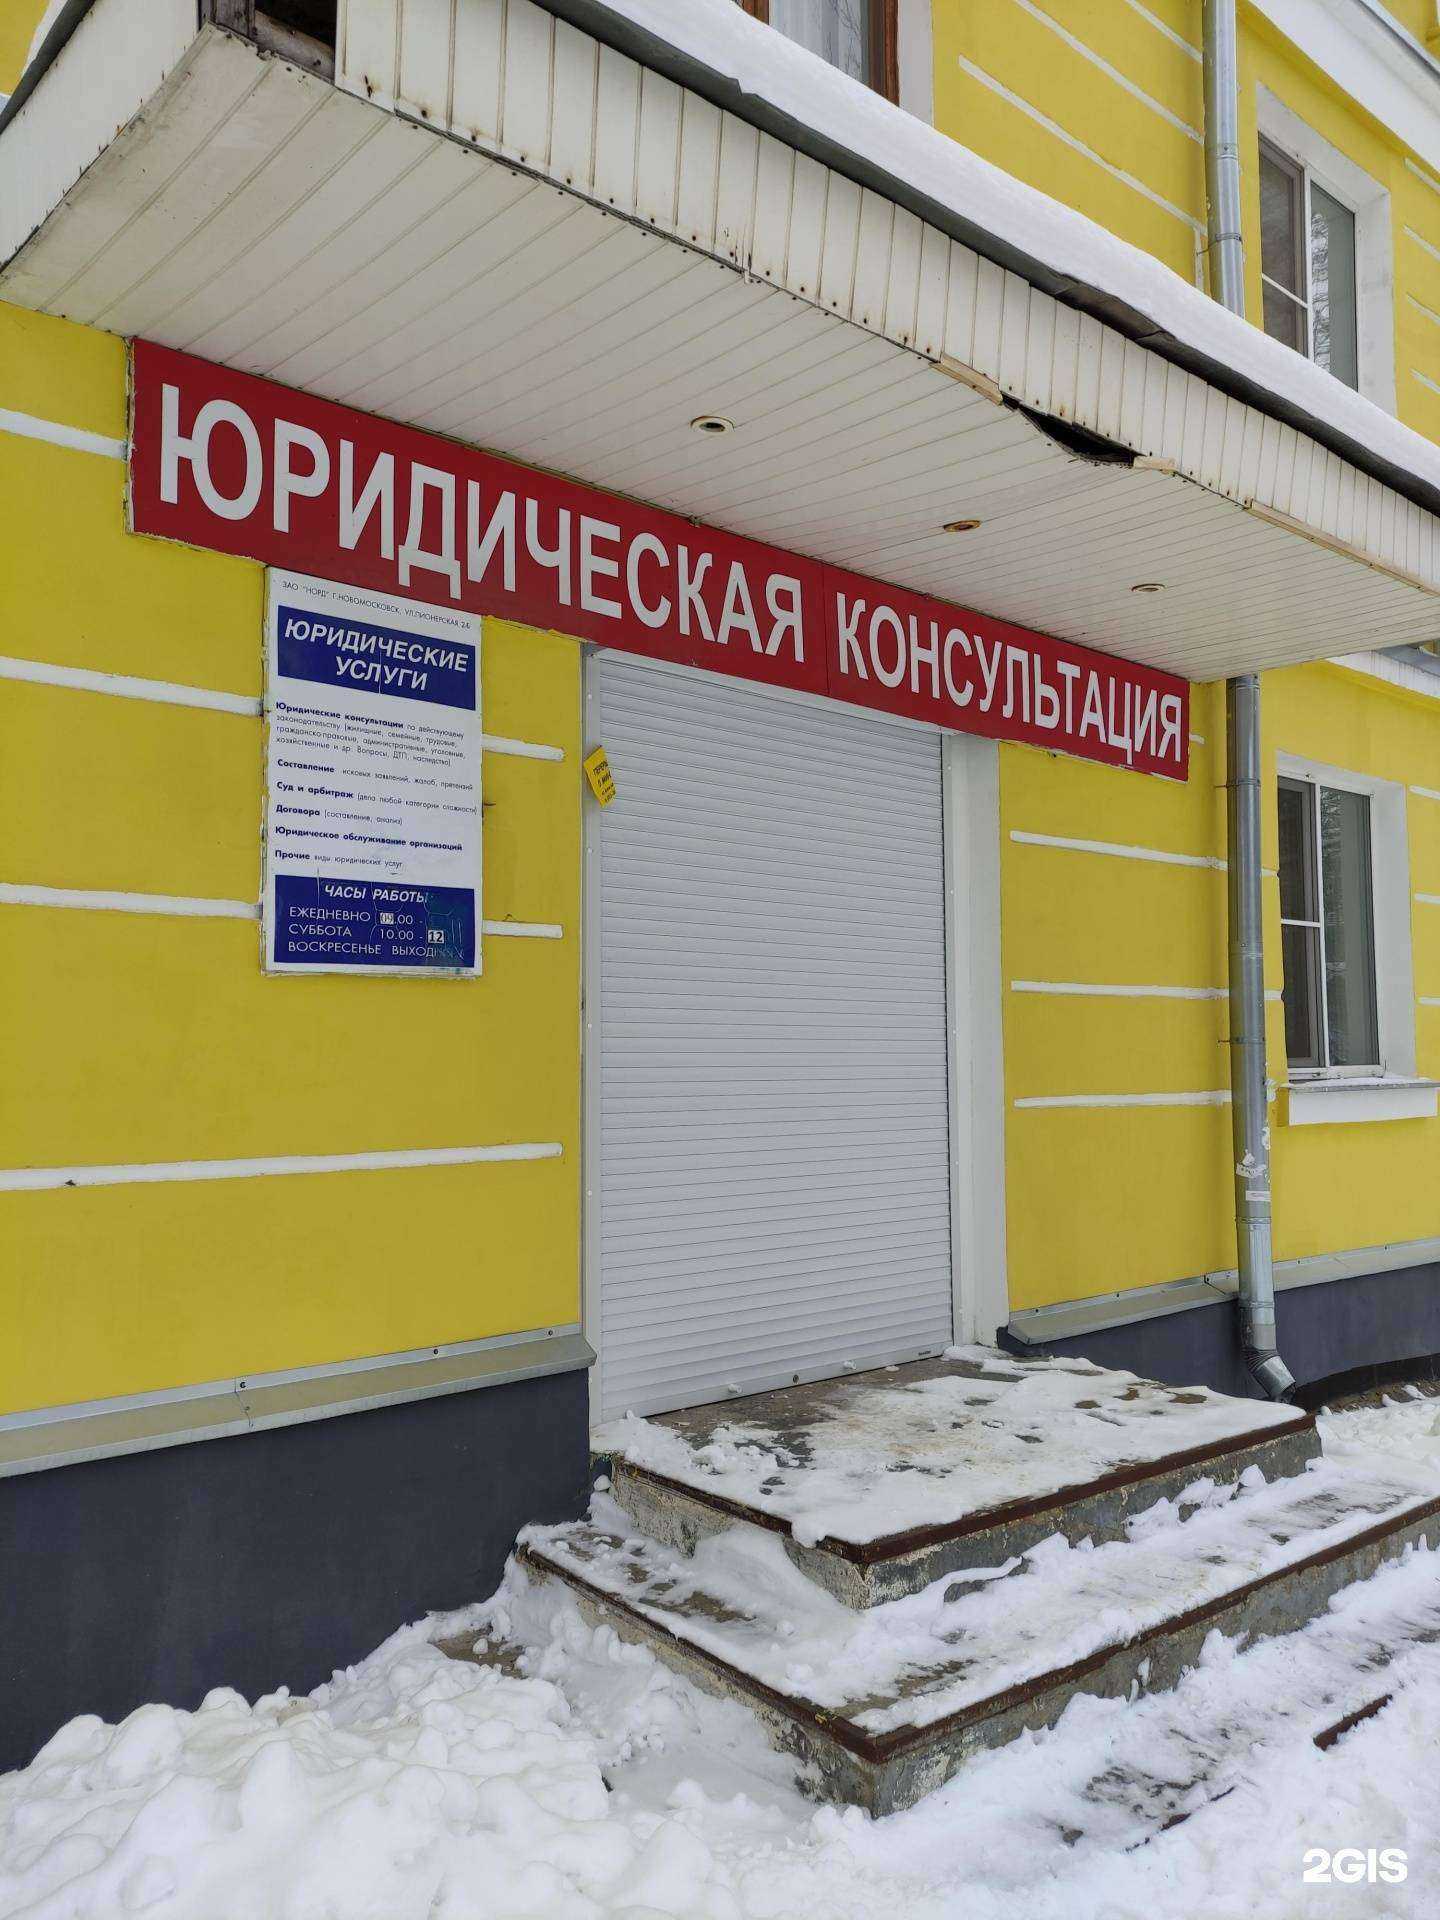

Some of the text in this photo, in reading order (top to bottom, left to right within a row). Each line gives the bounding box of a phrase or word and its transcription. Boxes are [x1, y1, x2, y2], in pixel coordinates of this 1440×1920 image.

[161, 383, 1182, 765] ЮРИДИЧЕСКАЯ КОНСУЛЬТАЦИЯ
[282, 581, 299, 590] ЗАО
[284, 618, 469, 672] ЮРИДИЧЕСКИЕ
[335, 655, 428, 691] УСЛУГИ
[276, 702, 341, 719] Юридические
[344, 714, 404, 729] консультации
[276, 715, 341, 732] законодательству
[276, 737, 330, 750] хозяйственные
[278, 759, 335, 773] Составление
[276, 782, 294, 792] Суд
[308, 786, 354, 798] арбитраж
[276, 804, 320, 818] Договора
[276, 826, 462, 851] Юридическое обслуживание организаций
[275, 850, 310, 860] Прочие
[384, 858, 402, 870] услуг
[325, 885, 429, 903] ЧАСЫ РАБОТЫ
[289, 906, 371, 922] ЕЖЕДНЕВНО
[288, 924, 352, 937] СУББОТА
[380, 928, 414, 940] 10.00
[428, 931, 444, 943] 12
[288, 941, 382, 955] ВОСКРЕСЕНЬЕ
